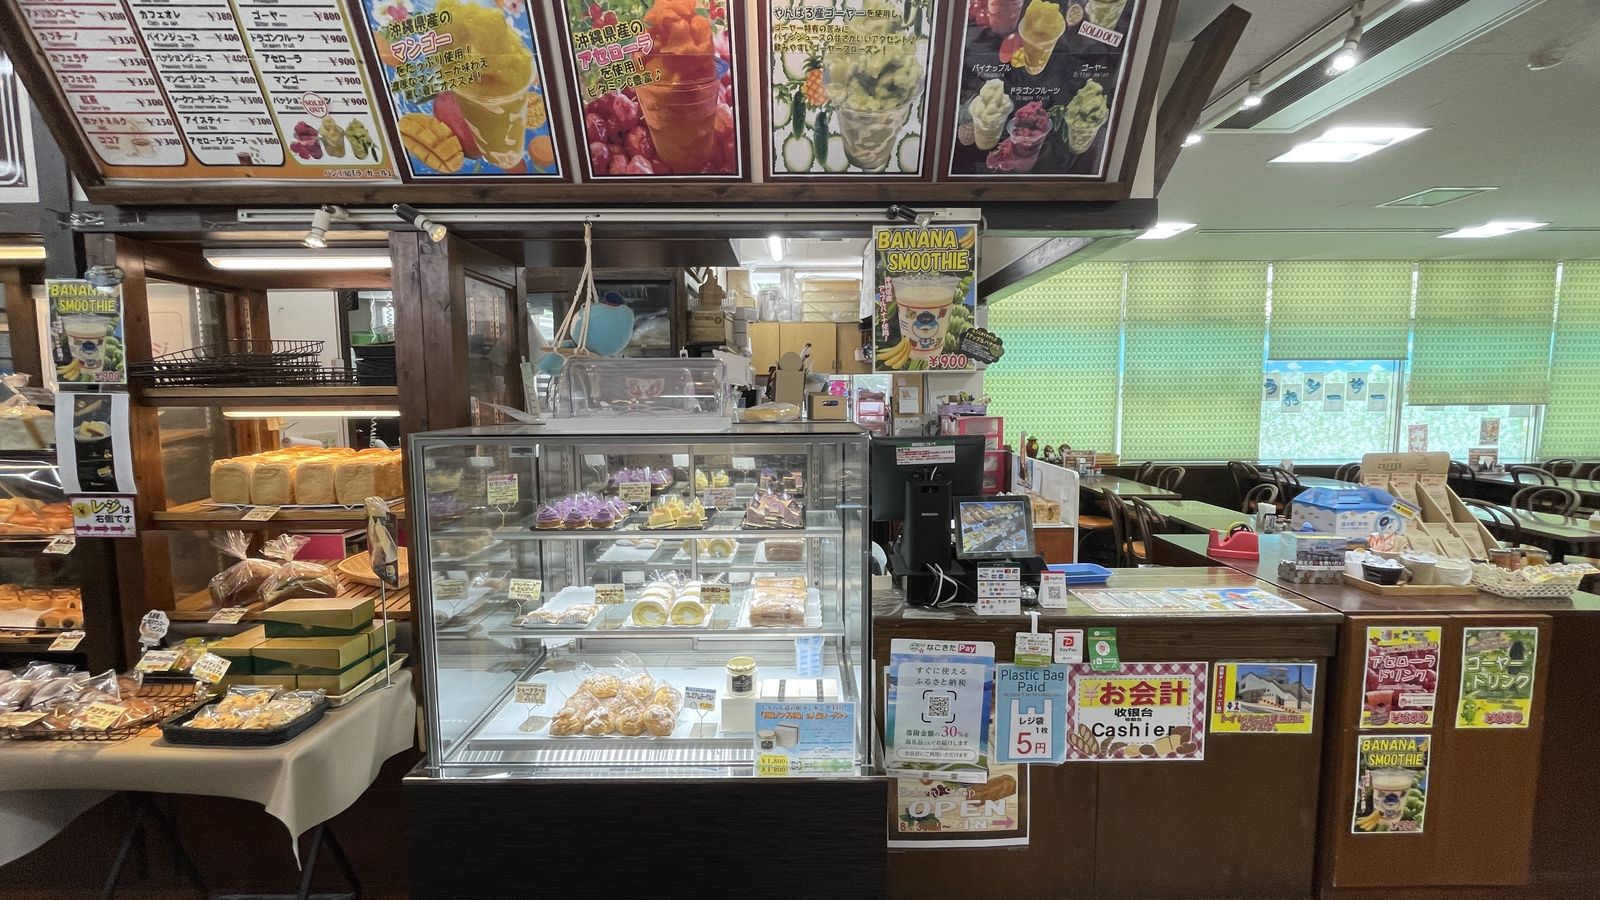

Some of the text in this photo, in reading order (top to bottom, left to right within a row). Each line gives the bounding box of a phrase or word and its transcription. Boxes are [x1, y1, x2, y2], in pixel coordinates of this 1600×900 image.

[140, 10, 180, 19] カフェオレ
[252, 11, 287, 20] ゴーヤー
[389, 10, 451, 36] 沖縄県産の
[147, 33, 200, 42] パインジュース
[251, 33, 348, 44] ドラゴンフルーツ ¥900
[575, 20, 643, 48] 沖縄県産の
[1081, 23, 1122, 45] SOLD OUT
[108, 36, 137, 45] ¥350
[391, 31, 453, 62] マンゴー
[577, 33, 653, 69] アセローラ
[156, 54, 214, 62] パッションジュース
[262, 54, 356, 66] アセローラ ¥900
[972, 63, 1012, 72] パイナップル
[1081, 63, 1108, 72] ゴーヤー
[164, 75, 218, 83] マンゴージュース
[274, 75, 361, 85] マンゴー ¥900
[1010, 87, 1061, 95] ドラゴンフルーツ
[343, 97, 368, 106] ¥900
[183, 116, 230, 124] アイスティー
[877, 229, 959, 250] BANANA
[887, 251, 969, 272] SMOOTHIE
[59, 299, 117, 312] SMOOTHIE
[929, 354, 968, 368] ¥900
[90, 499, 131, 514] レジは
[95, 515, 132, 524] 右側です
[958, 644, 976, 654] Pay
[1370, 655, 1436, 668] アセローラ
[1468, 656, 1525, 671] ゴーヤー
[916, 667, 967, 676] すぐに使える
[1001, 669, 1065, 682] Plastic Bag
[1378, 670, 1427, 682] ドリンク
[915, 678, 967, 687] ふるさと納税
[1018, 681, 1046, 692] Paid
[1473, 673, 1530, 689] ドリンク
[1099, 680, 1188, 706] お会計
[1115, 708, 1153, 717] 收银台
[1019, 717, 1044, 725] レジ袋
[1092, 722, 1175, 737] Cashier
[1017, 732, 1046, 754] 5円
[1362, 739, 1417, 751] BANANA
[1368, 753, 1424, 766] SMOOTHIE
[909, 799, 1006, 817] OPEN
[963, 819, 988, 830] IN
